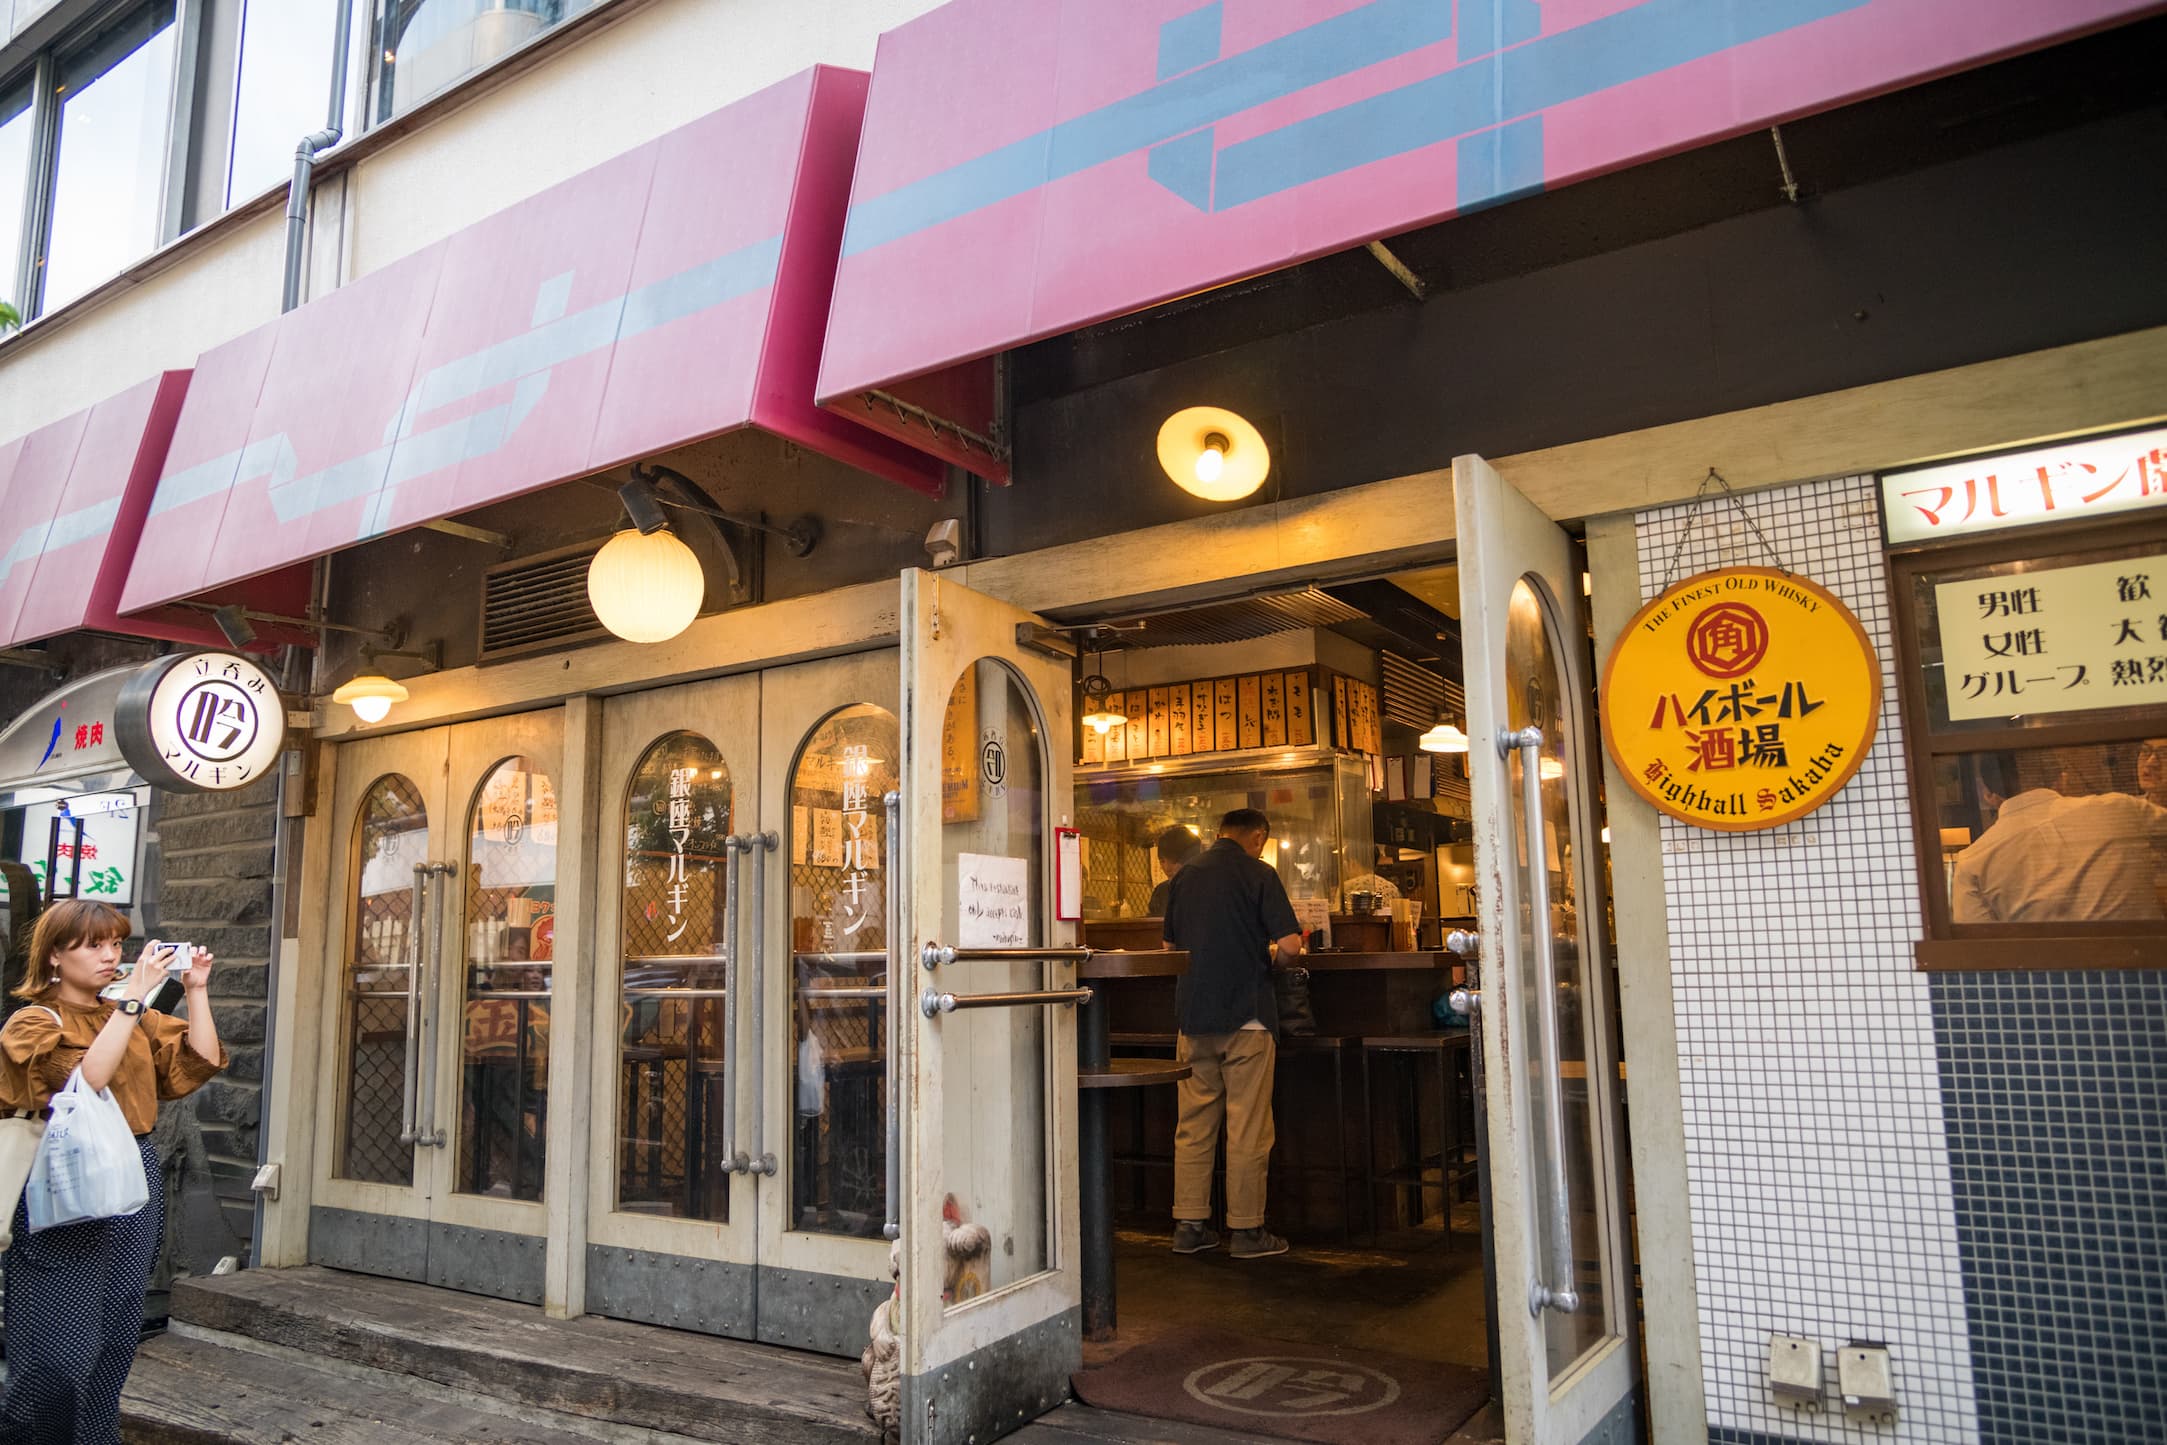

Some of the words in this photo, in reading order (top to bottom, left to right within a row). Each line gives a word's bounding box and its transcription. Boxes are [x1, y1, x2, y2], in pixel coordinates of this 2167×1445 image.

[1643, 608, 1672, 632] THE
[1671, 583, 1721, 611] FINEST
[1725, 577, 1759, 590] OLD
[1764, 578, 1821, 613] WHISKY
[1978, 587, 2044, 619] 男性
[1982, 628, 2048, 660] 女性
[193, 658, 266, 695] 立呑み
[1960, 664, 2090, 700] グループ
[1650, 679, 1825, 729] ハイボール
[74, 721, 104, 751] 焼肉
[1684, 723, 1789, 772] 酒場
[165, 741, 252, 785] マルギン
[1643, 758, 1747, 815] Highball
[1757, 742, 1844, 813] Sakaba
[667, 767, 691, 942] 銀座マルギン
[842, 744, 868, 936] 銀座マルギン
